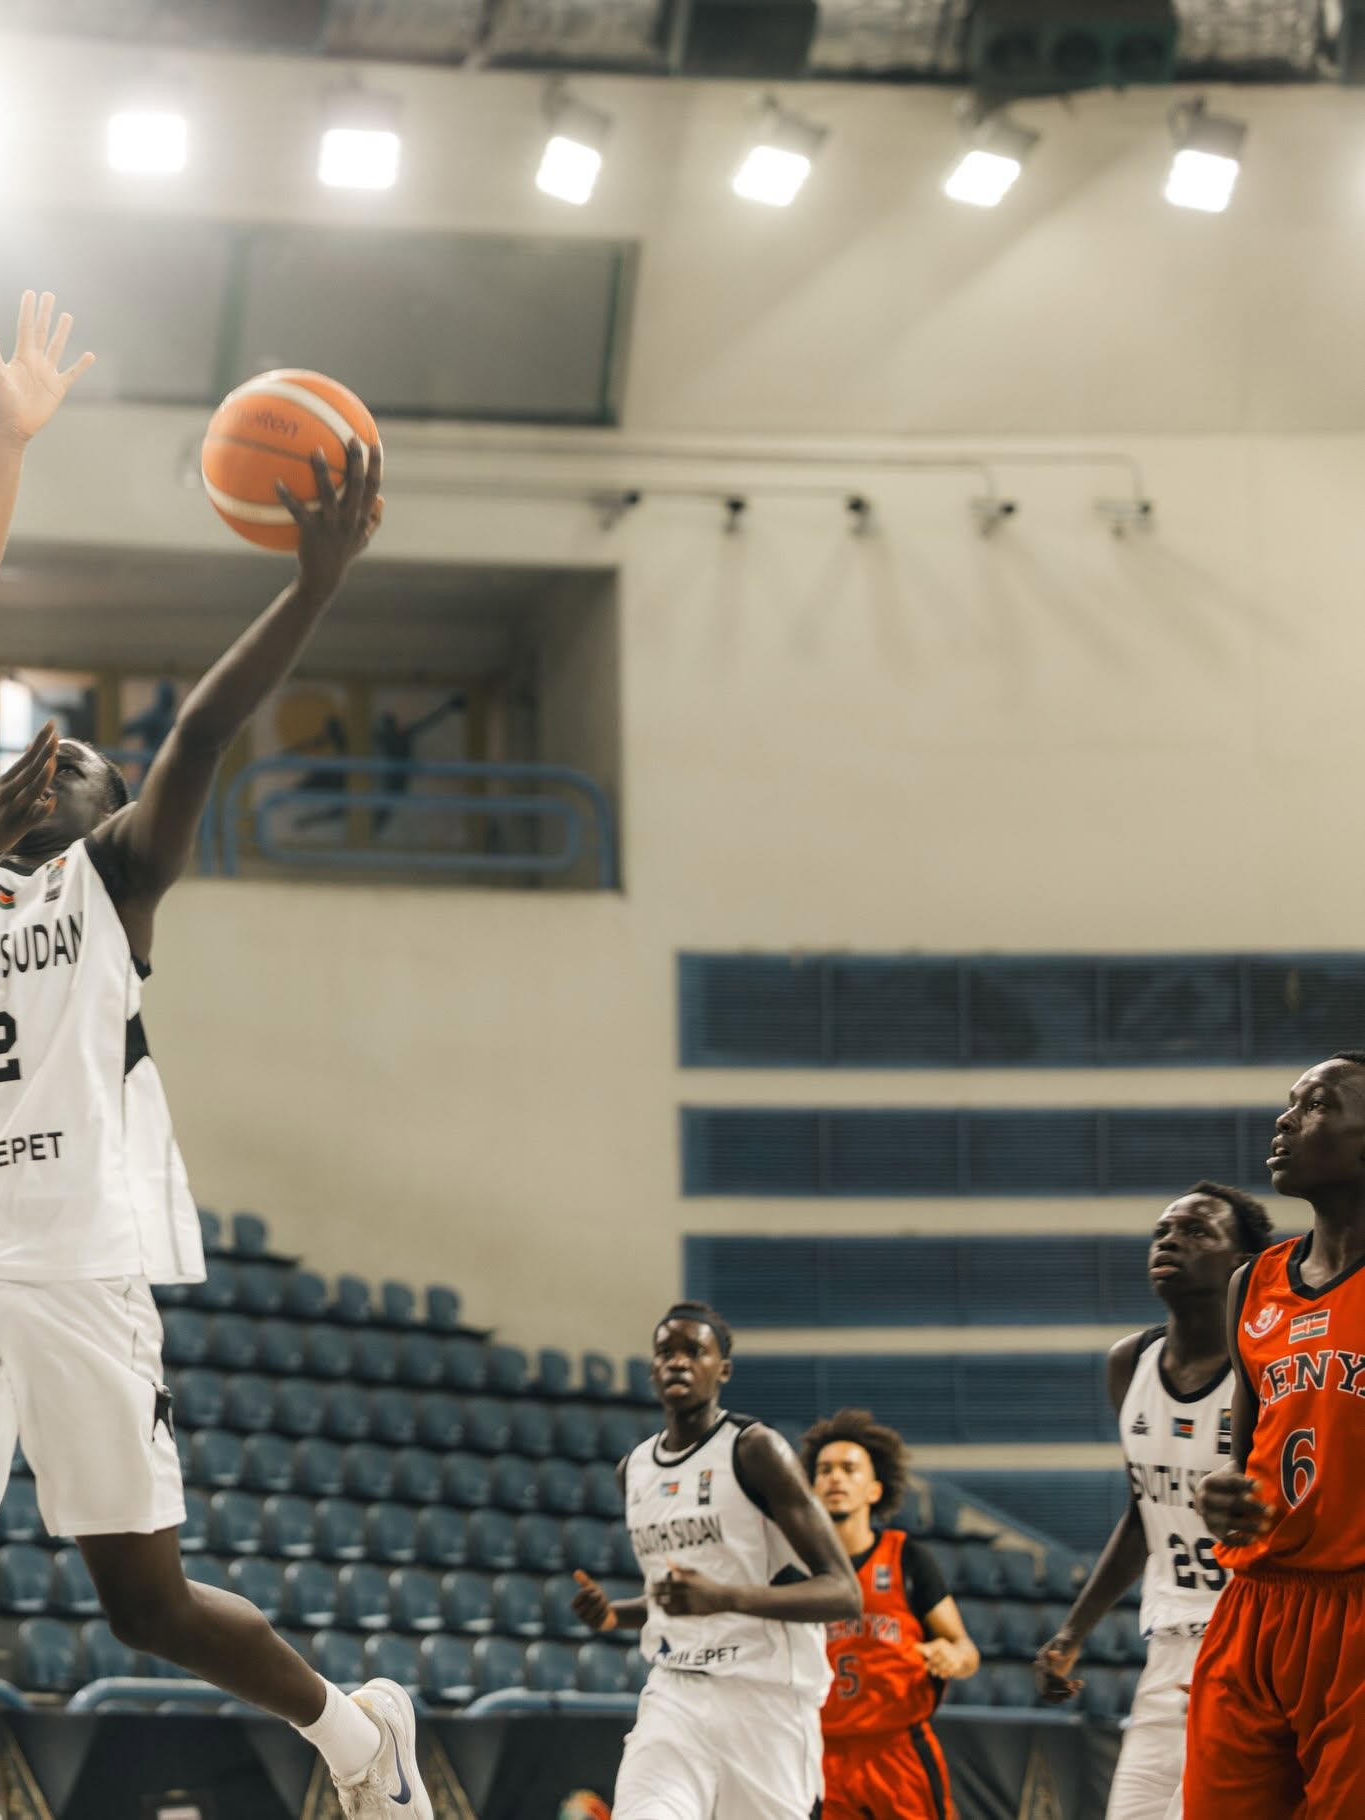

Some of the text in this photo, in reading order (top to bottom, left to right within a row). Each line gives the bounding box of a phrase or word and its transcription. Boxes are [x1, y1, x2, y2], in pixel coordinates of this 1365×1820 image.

[0, 912, 84, 979] SUDAN
[1259, 1349, 1365, 1409] ENY
[1280, 1427, 1317, 1509] 6
[836, 1653, 860, 1699] 5
